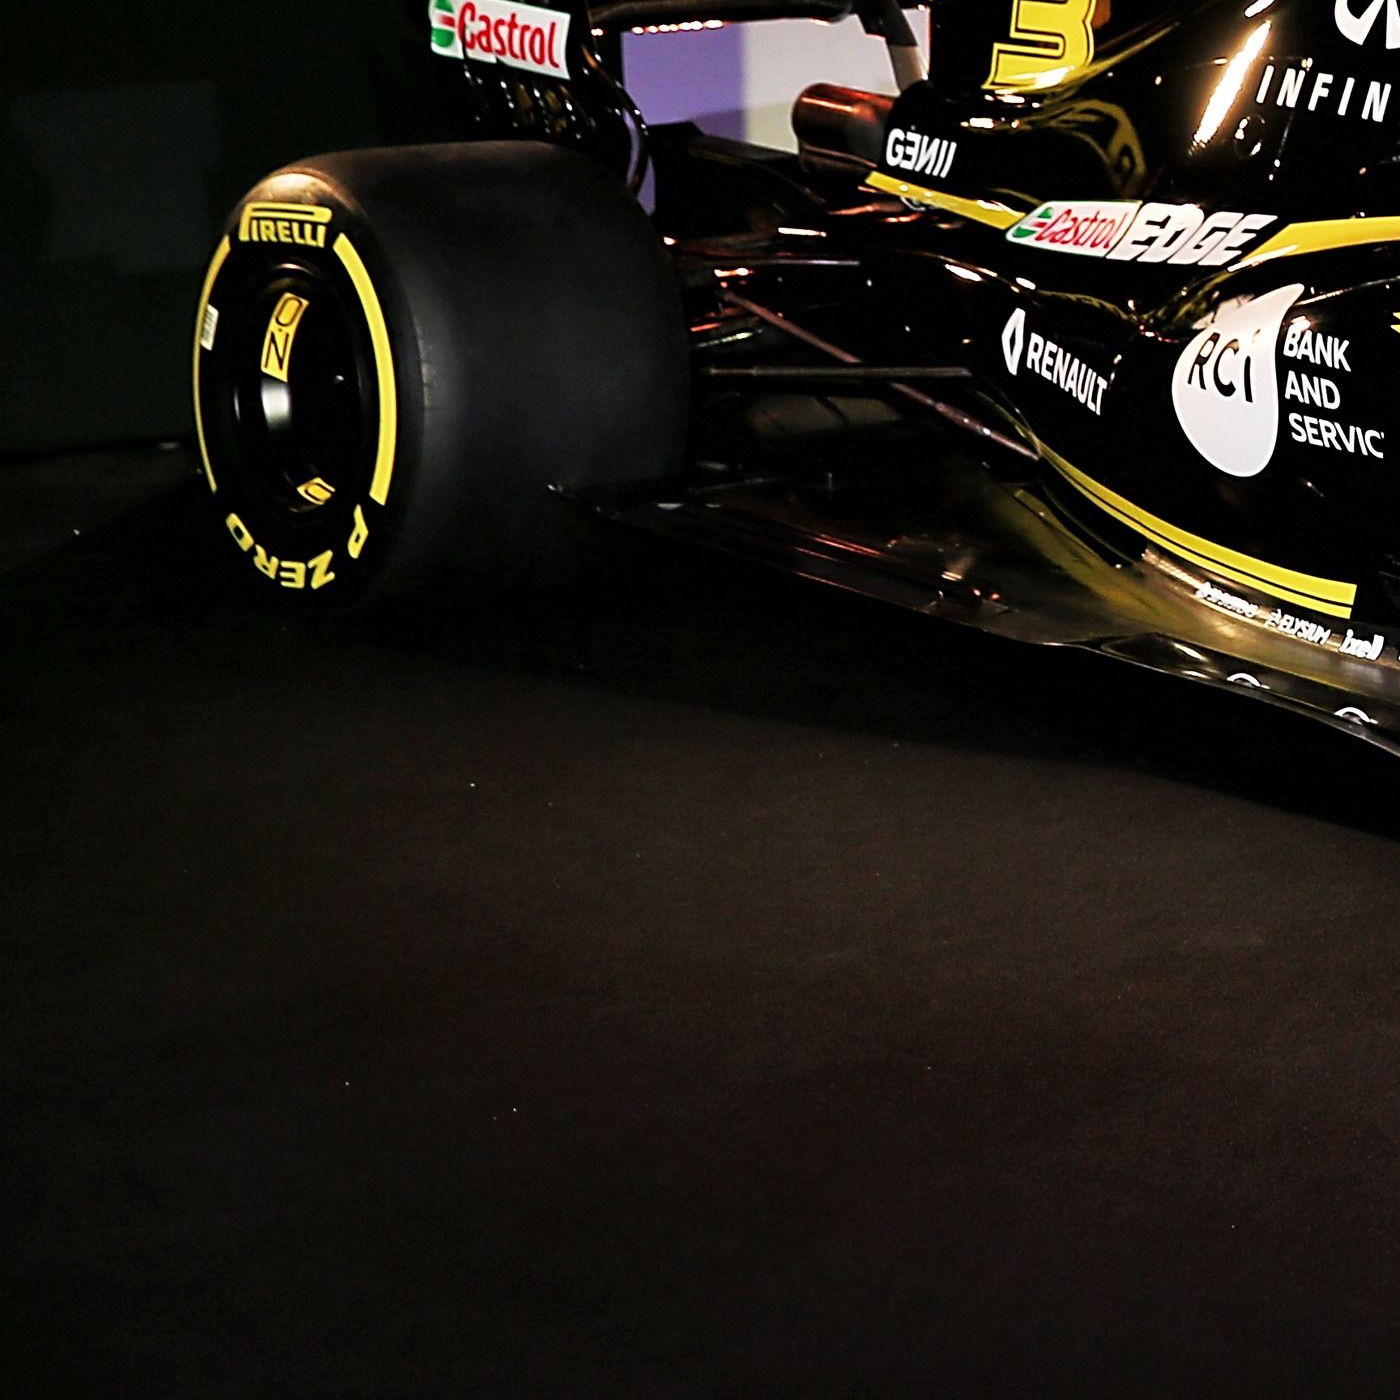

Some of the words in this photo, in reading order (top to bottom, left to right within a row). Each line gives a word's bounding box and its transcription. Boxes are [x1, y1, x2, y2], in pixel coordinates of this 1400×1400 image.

[457, 0, 560, 69] Castrol
[239, 202, 332, 248] PIRELLI
[1034, 208, 1129, 250] Castrol
[1105, 202, 1280, 266] EDGE
[1026, 332, 1108, 416] RENAULT
[1283, 321, 1352, 372] BANK
[1284, 370, 1341, 411] AND
[1288, 412, 1386, 459] SERVIC
[225, 512, 335, 589] ZERO
[347, 504, 369, 559] P
